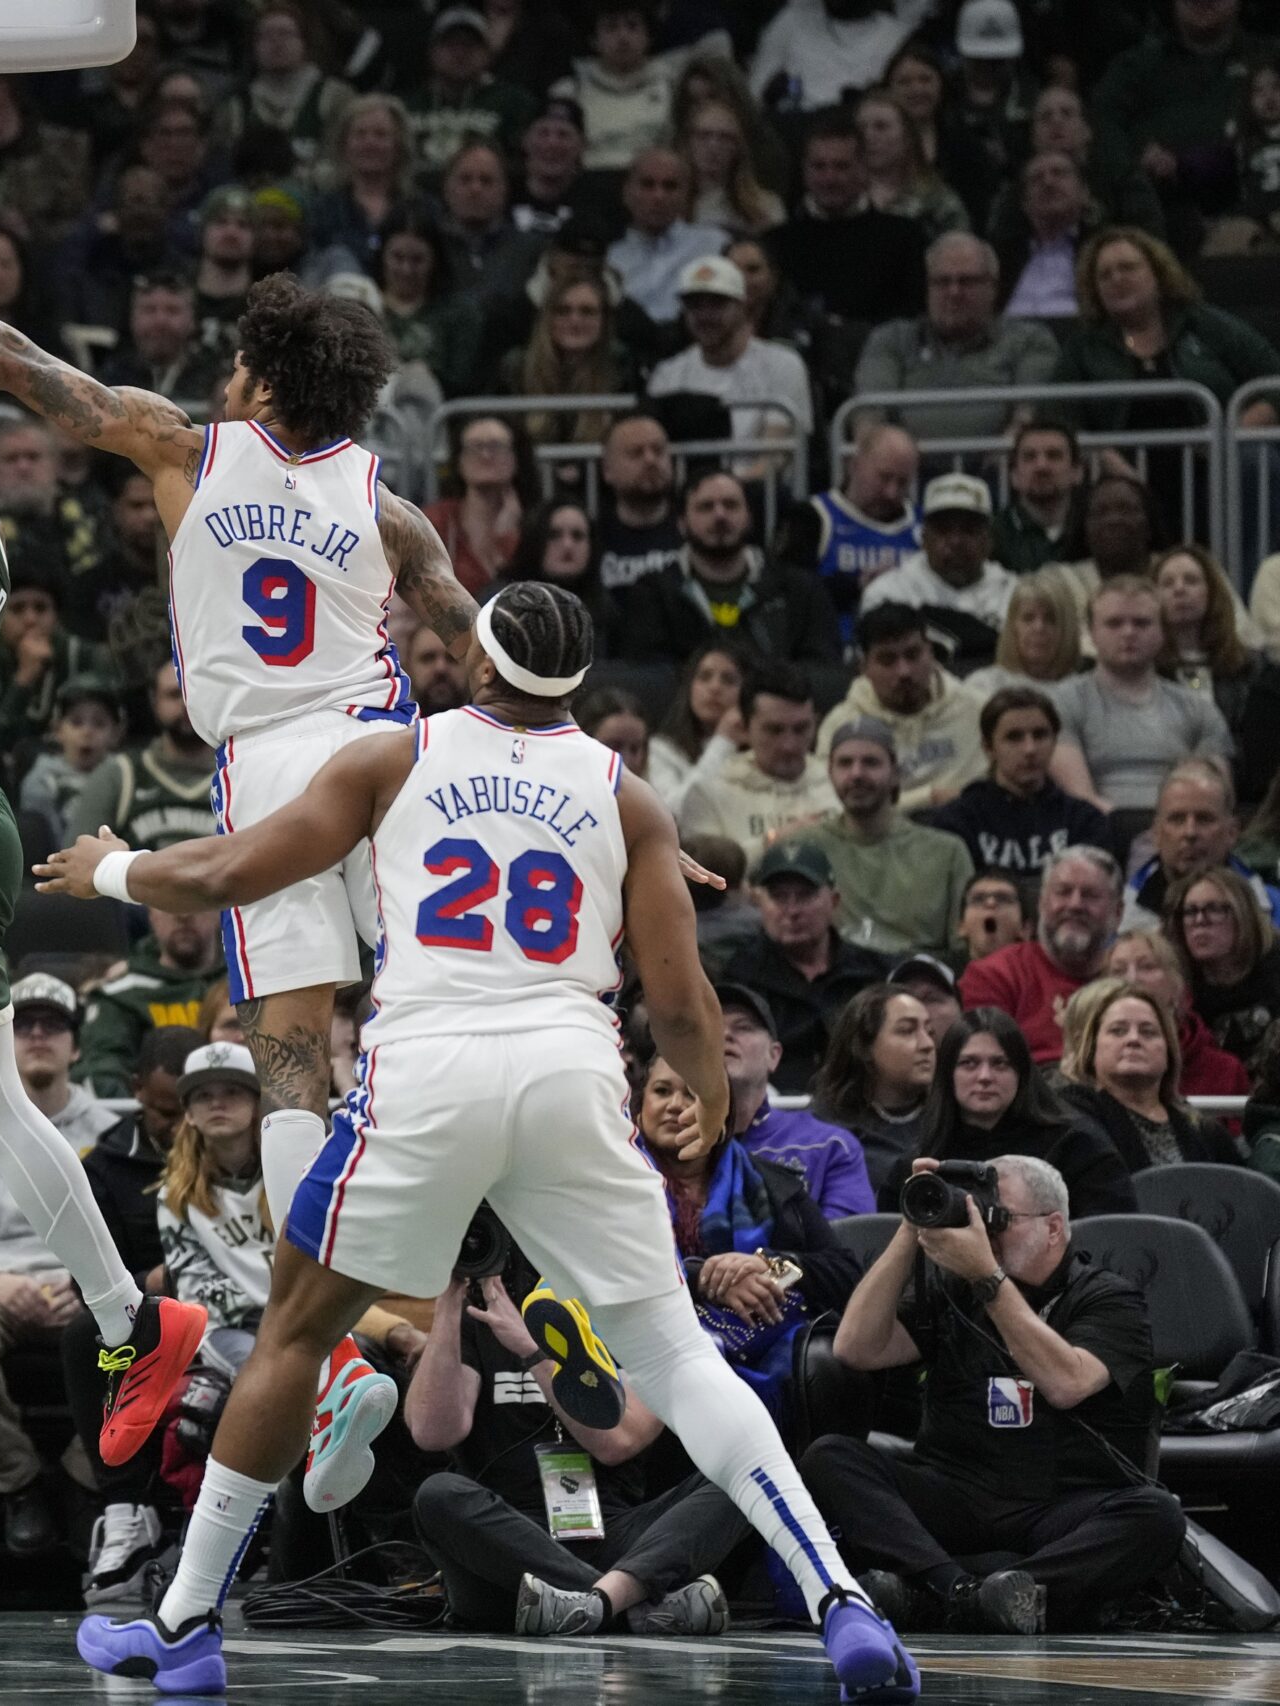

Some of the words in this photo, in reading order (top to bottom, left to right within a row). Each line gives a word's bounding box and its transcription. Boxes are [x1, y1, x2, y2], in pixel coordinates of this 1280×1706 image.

[205, 504, 312, 548] OUBRE
[311, 522, 360, 572] JR.
[242, 557, 317, 667] 9
[425, 776, 598, 847] YABUSELE
[415, 837, 584, 965] 28
[995, 1405, 1016, 1422] NBA
